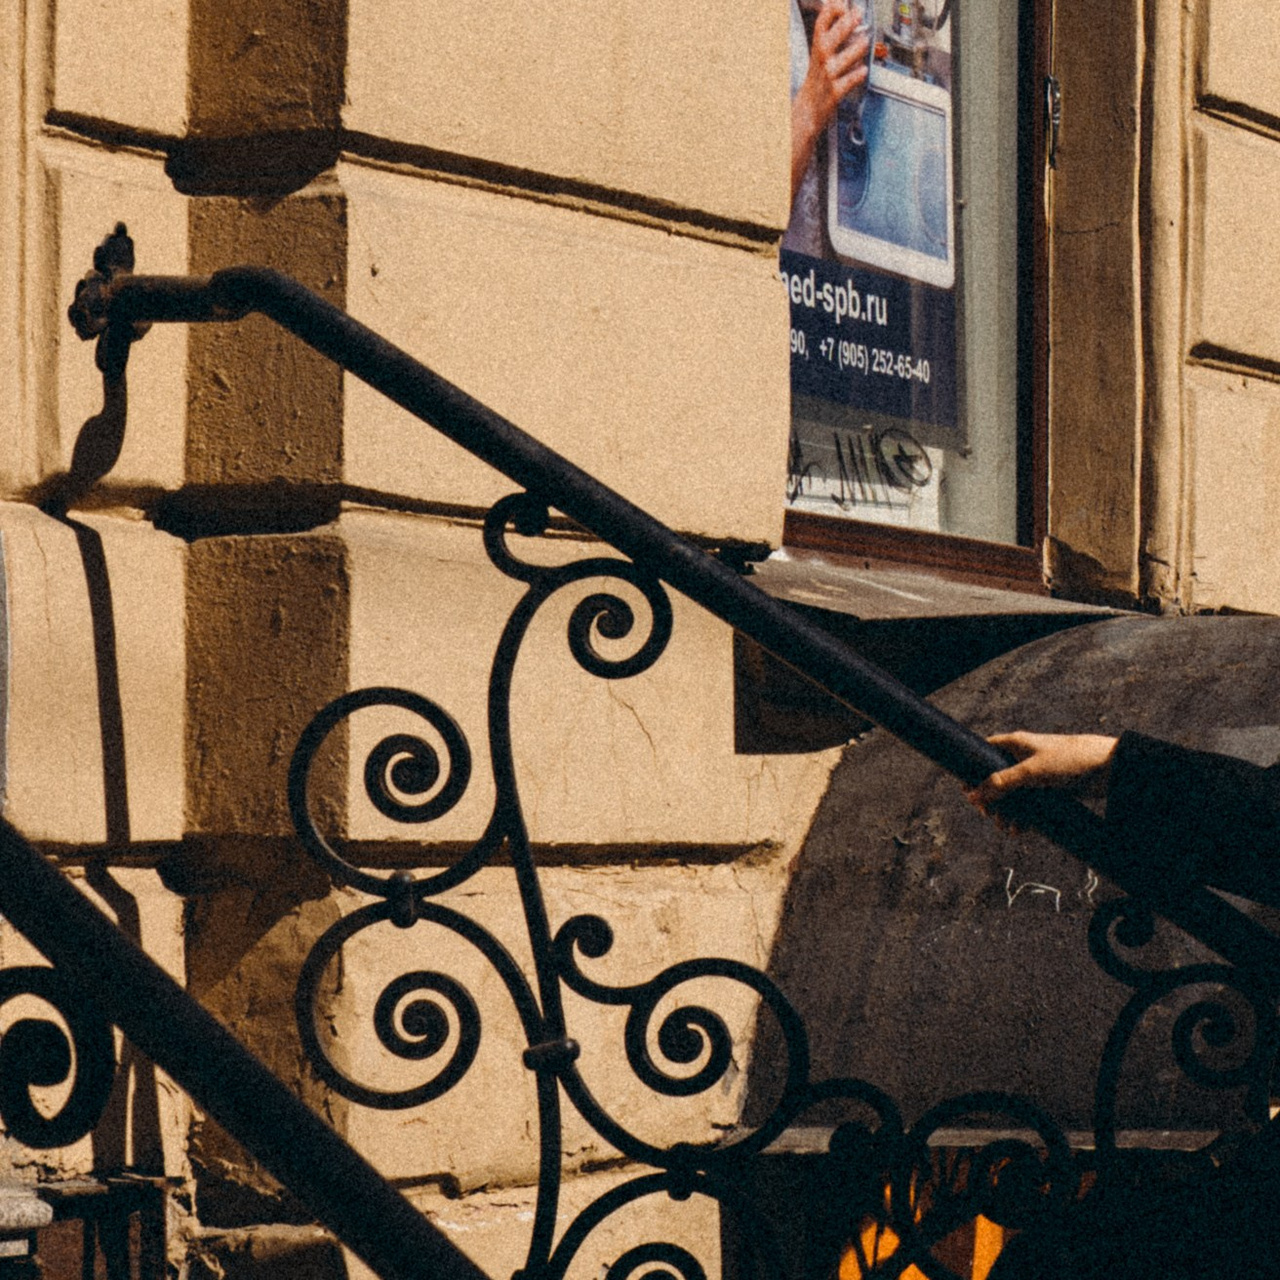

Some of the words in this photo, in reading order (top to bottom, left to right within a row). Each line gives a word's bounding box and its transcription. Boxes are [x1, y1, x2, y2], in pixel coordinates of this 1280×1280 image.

[819, 337, 834, 361] +7
[838, 340, 869, 376] (905)
[872, 347, 931, 384] 252-65-40
